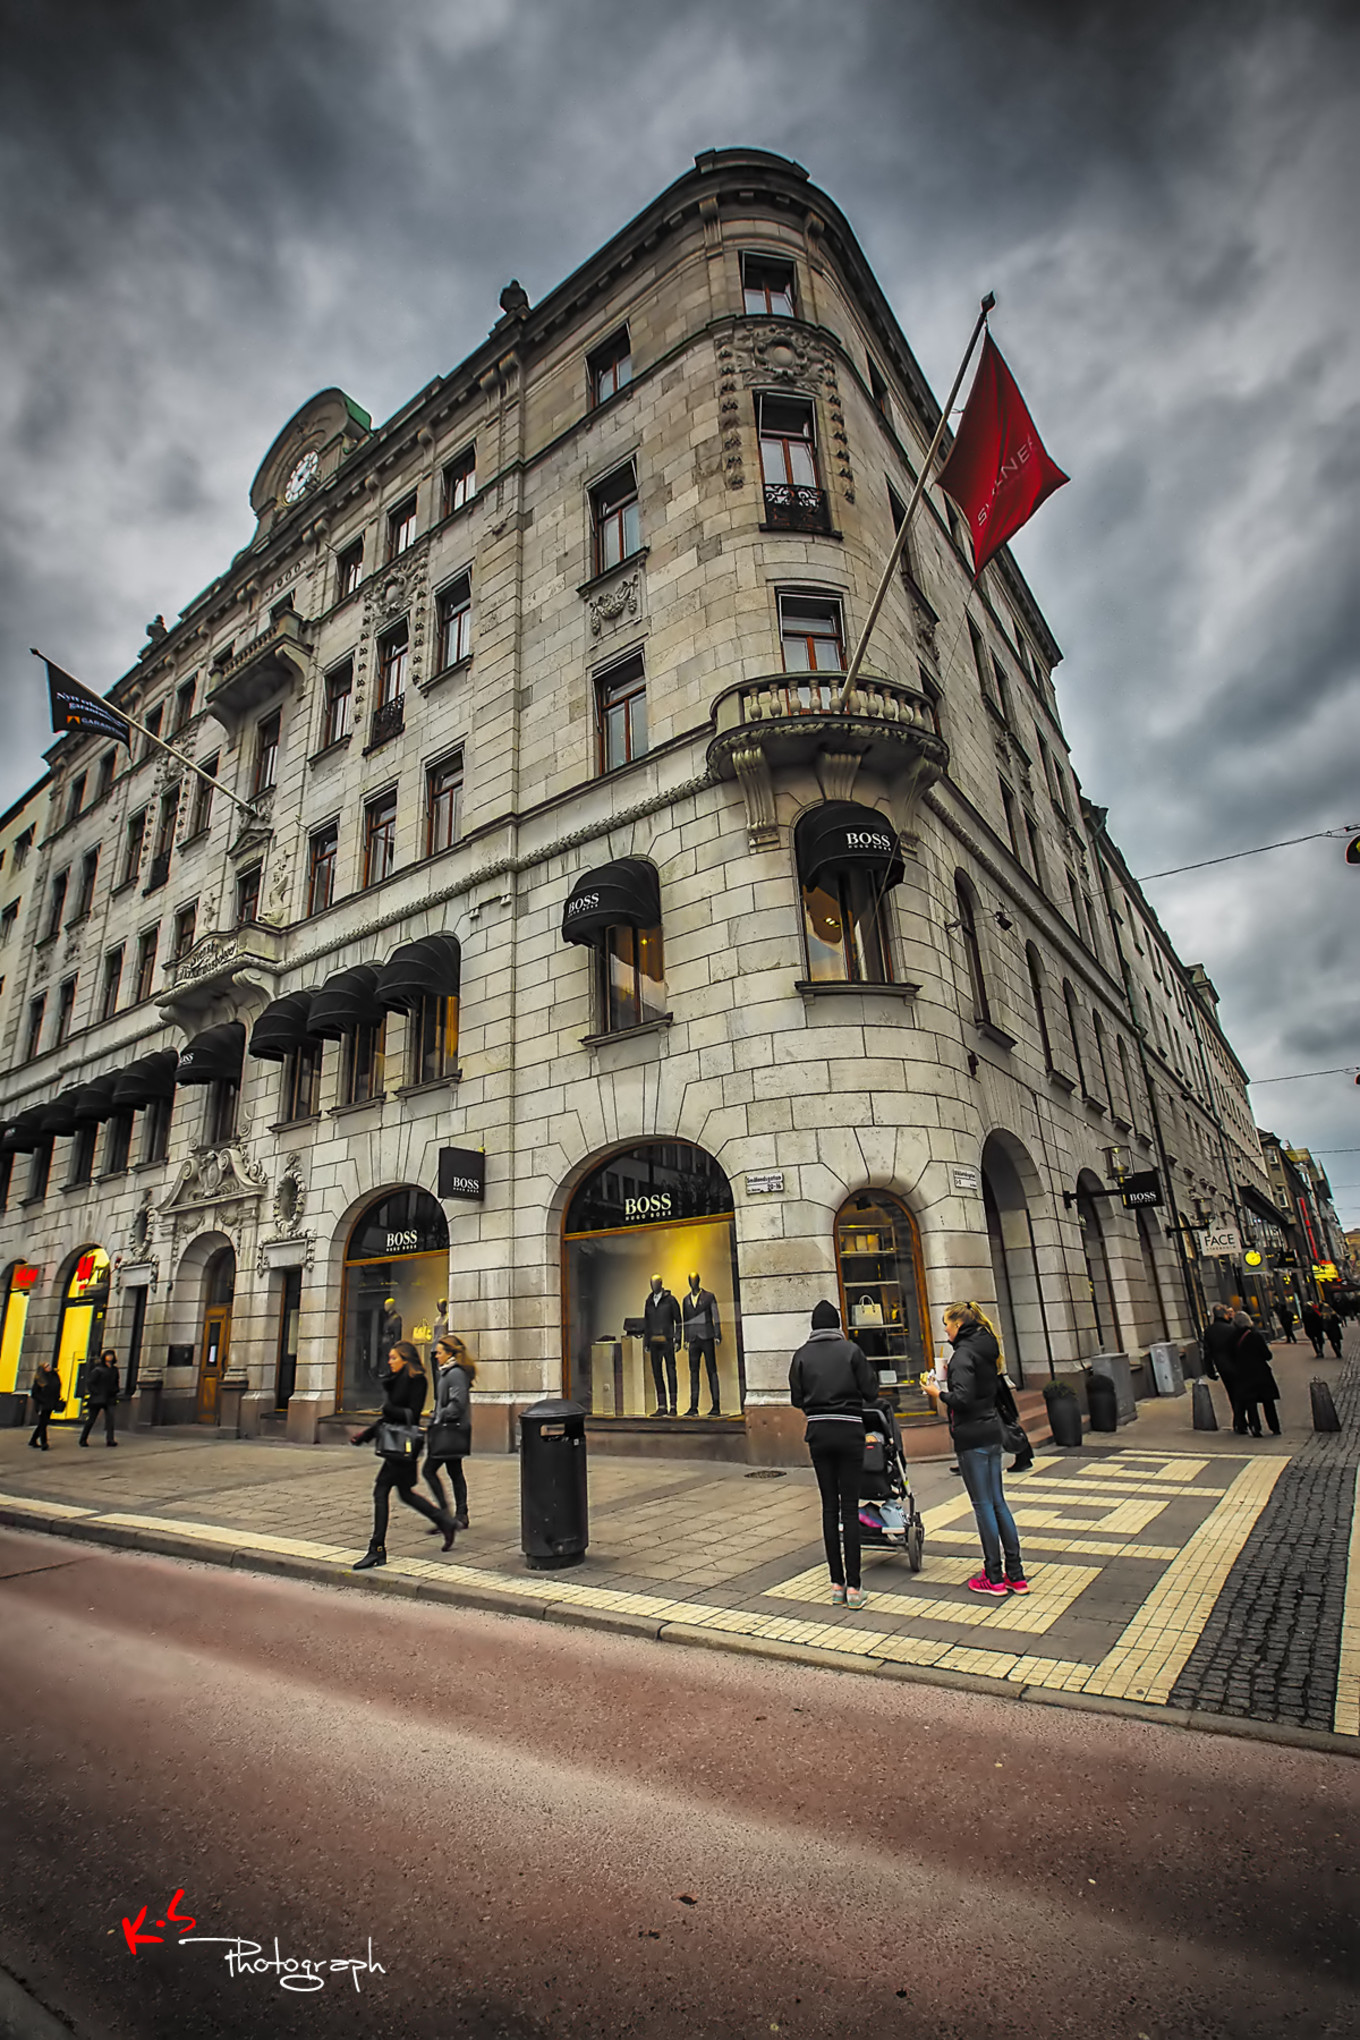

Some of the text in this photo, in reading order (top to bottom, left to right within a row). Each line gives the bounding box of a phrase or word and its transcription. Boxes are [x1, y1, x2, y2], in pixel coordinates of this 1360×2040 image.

[846, 832, 891, 847] BOSS
[568, 892, 599, 914] BOSS
[453, 1176, 479, 1190] BOSS
[1130, 1191, 1157, 1201] BOSS
[625, 1193, 671, 1215] BOSS
[386, 1230, 418, 1247] BOSS
[1204, 1234, 1236, 1246] FACE
